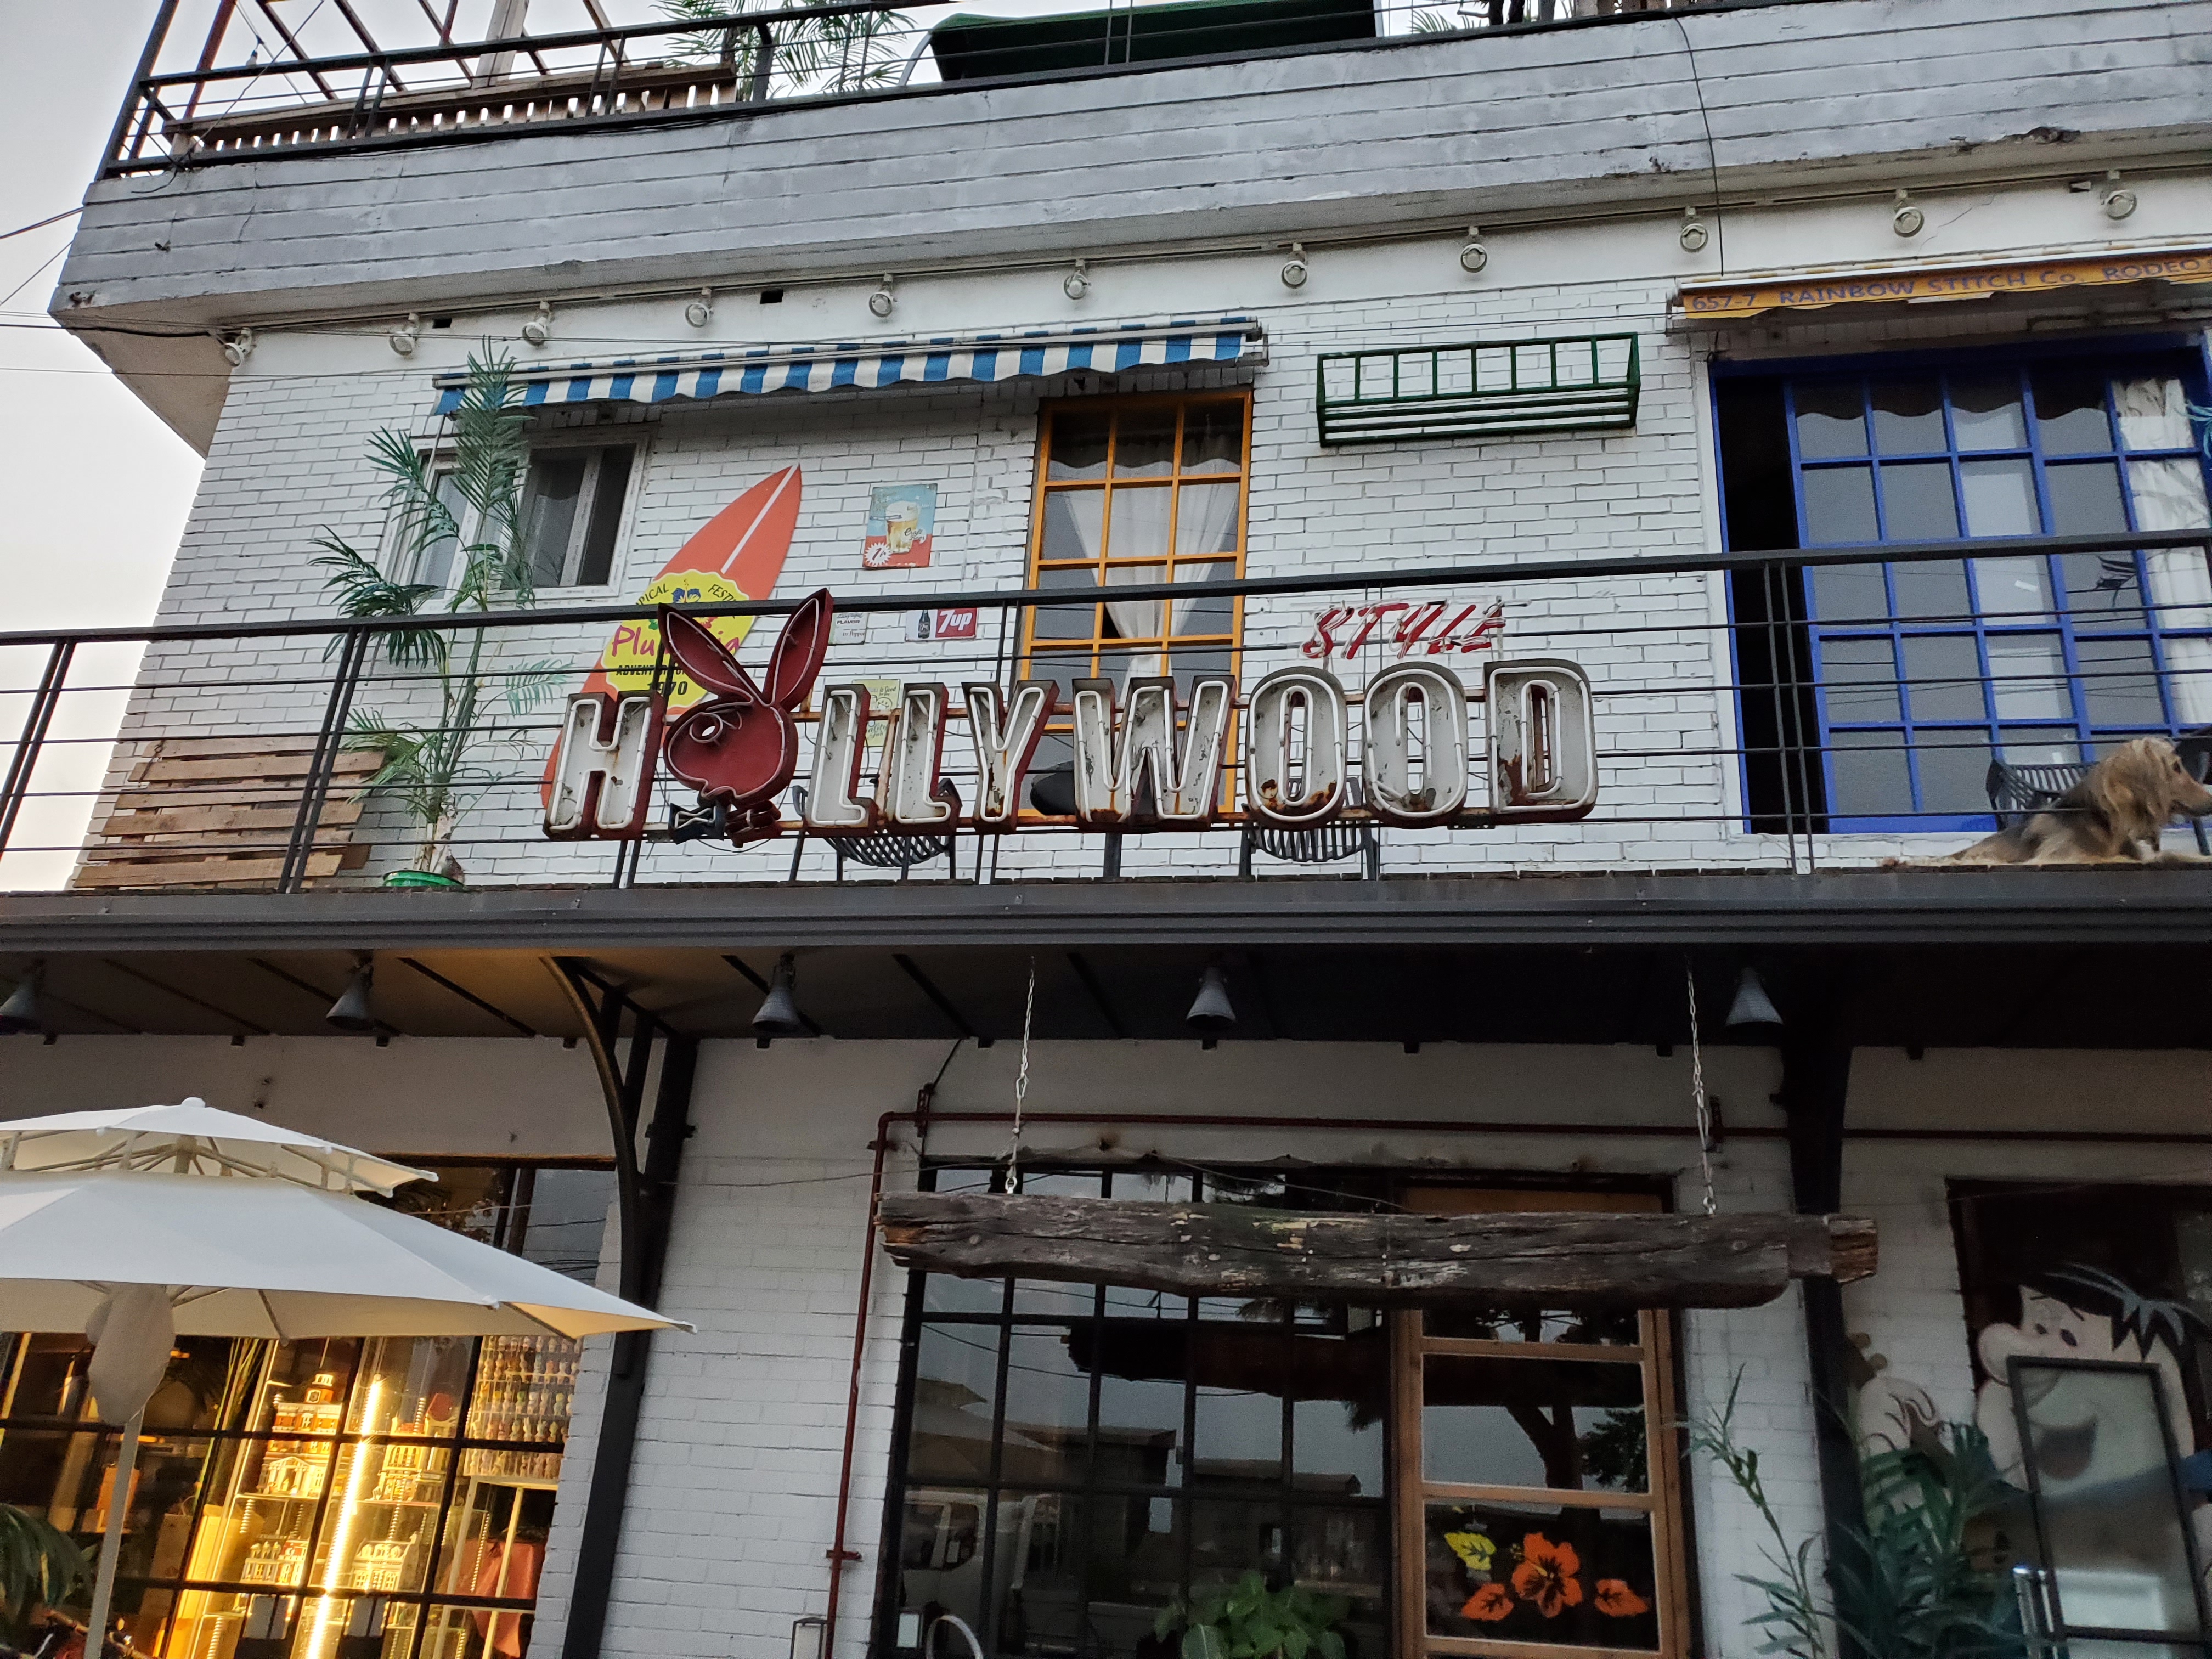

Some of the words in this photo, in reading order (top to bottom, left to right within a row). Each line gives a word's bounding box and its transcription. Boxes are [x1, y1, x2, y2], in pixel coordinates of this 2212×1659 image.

[1692, 292, 1756, 311] 657-7
[1780, 280, 1915, 304] RAINBOW
[1927, 271, 2026, 292] STITCH
[2102, 259, 2200, 281] RODEO
[1300, 600, 1506, 660] STYLE
[543, 659, 1598, 840] HLLYWOOD
